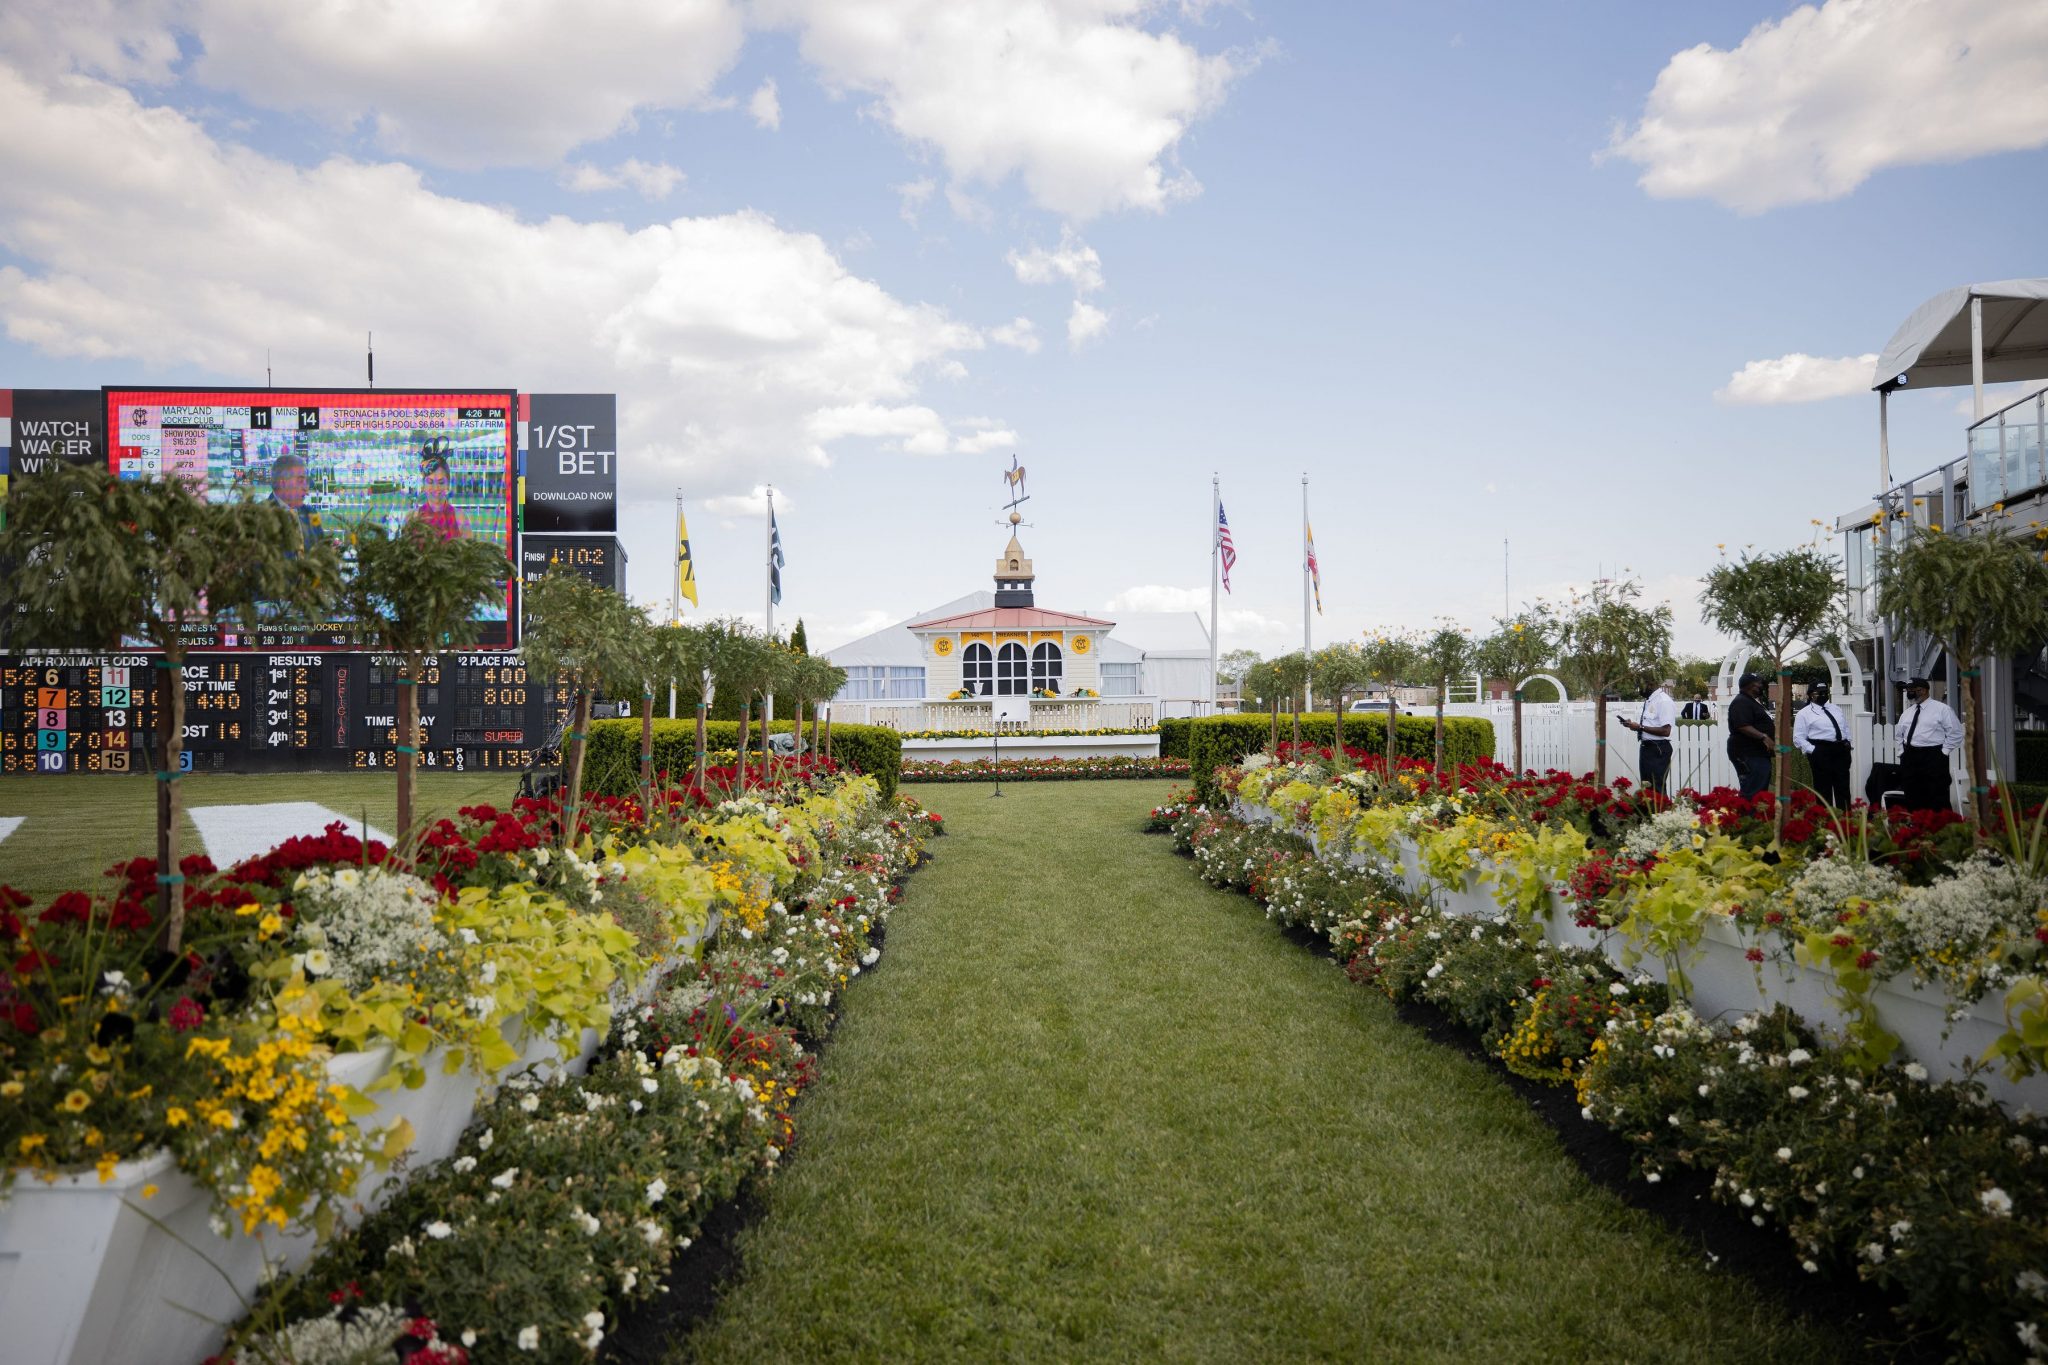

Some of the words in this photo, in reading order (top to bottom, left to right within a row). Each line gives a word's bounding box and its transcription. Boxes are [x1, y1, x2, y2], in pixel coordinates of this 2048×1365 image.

[162, 406, 212, 415] MARYLAND
[226, 407, 250, 416] RACE
[275, 408, 298, 416] MINS
[333, 409, 378, 418] STRONACH
[380, 409, 386, 418] 5
[465, 409, 482, 418] 4:26
[489, 409, 501, 418] PM
[162, 416, 192, 425] JOCKEY
[193, 416, 214, 424] CLUB
[255, 411, 267, 426] 11
[301, 412, 317, 426] 14
[334, 420, 361, 429] SUPER
[362, 420, 384, 429] HIGH
[385, 420, 391, 429] 5
[460, 420, 478, 428] FAST
[485, 420, 503, 428] FIRM
[20, 421, 89, 436] WATCH
[533, 425, 596, 448] 1/ST
[20, 439, 91, 455] WAGER
[128, 448, 133, 456] 1
[142, 448, 160, 456] 5-2
[127, 460, 134, 469] 2
[147, 460, 155, 469] 6
[559, 451, 615, 474] BET
[533, 492, 588, 500] DOWNLOAD
[590, 492, 613, 500] NOW
[524, 551, 546, 562] FINISH
[527, 572, 543, 582] MILE
[177, 637, 207, 646] ESULTS
[208, 638, 214, 646] 5
[113, 656, 149, 667] ODDS
[269, 656, 321, 666] RESULTS
[458, 657, 468, 666] $2
[470, 656, 500, 666] PLACE
[502, 656, 526, 666] PAYS
[45, 668, 59, 686] 6
[88, 668, 100, 686] 5
[108, 669, 124, 685] 11
[181, 666, 209, 678] ACE
[269, 669, 287, 683] 1st
[295, 668, 308, 684] 2
[207, 681, 235, 691] TIME
[24, 690, 37, 707] 6
[46, 690, 58, 707] 7
[105, 689, 127, 705] 12
[197, 693, 240, 710] 4:40
[268, 689, 288, 705] 2nd
[295, 688, 308, 705] 8
[24, 711, 37, 728] 7
[46, 711, 58, 727] 8
[105, 710, 127, 727] 13
[268, 710, 288, 726] 3rd
[295, 709, 308, 726] 9
[365, 716, 394, 726] TIME
[181, 725, 209, 737] OST
[295, 730, 308, 747] 3
[484, 731, 524, 742] SUPER
[46, 732, 58, 748] 9
[105, 731, 127, 748] 14
[268, 731, 288, 747] 4th
[41, 753, 63, 770] 10
[105, 753, 126, 769] 15
[355, 750, 367, 767] 2
[368, 751, 377, 766] &
[384, 750, 397, 767] 8
[427, 751, 436, 766] &
[456, 748, 464, 771] PAYS
